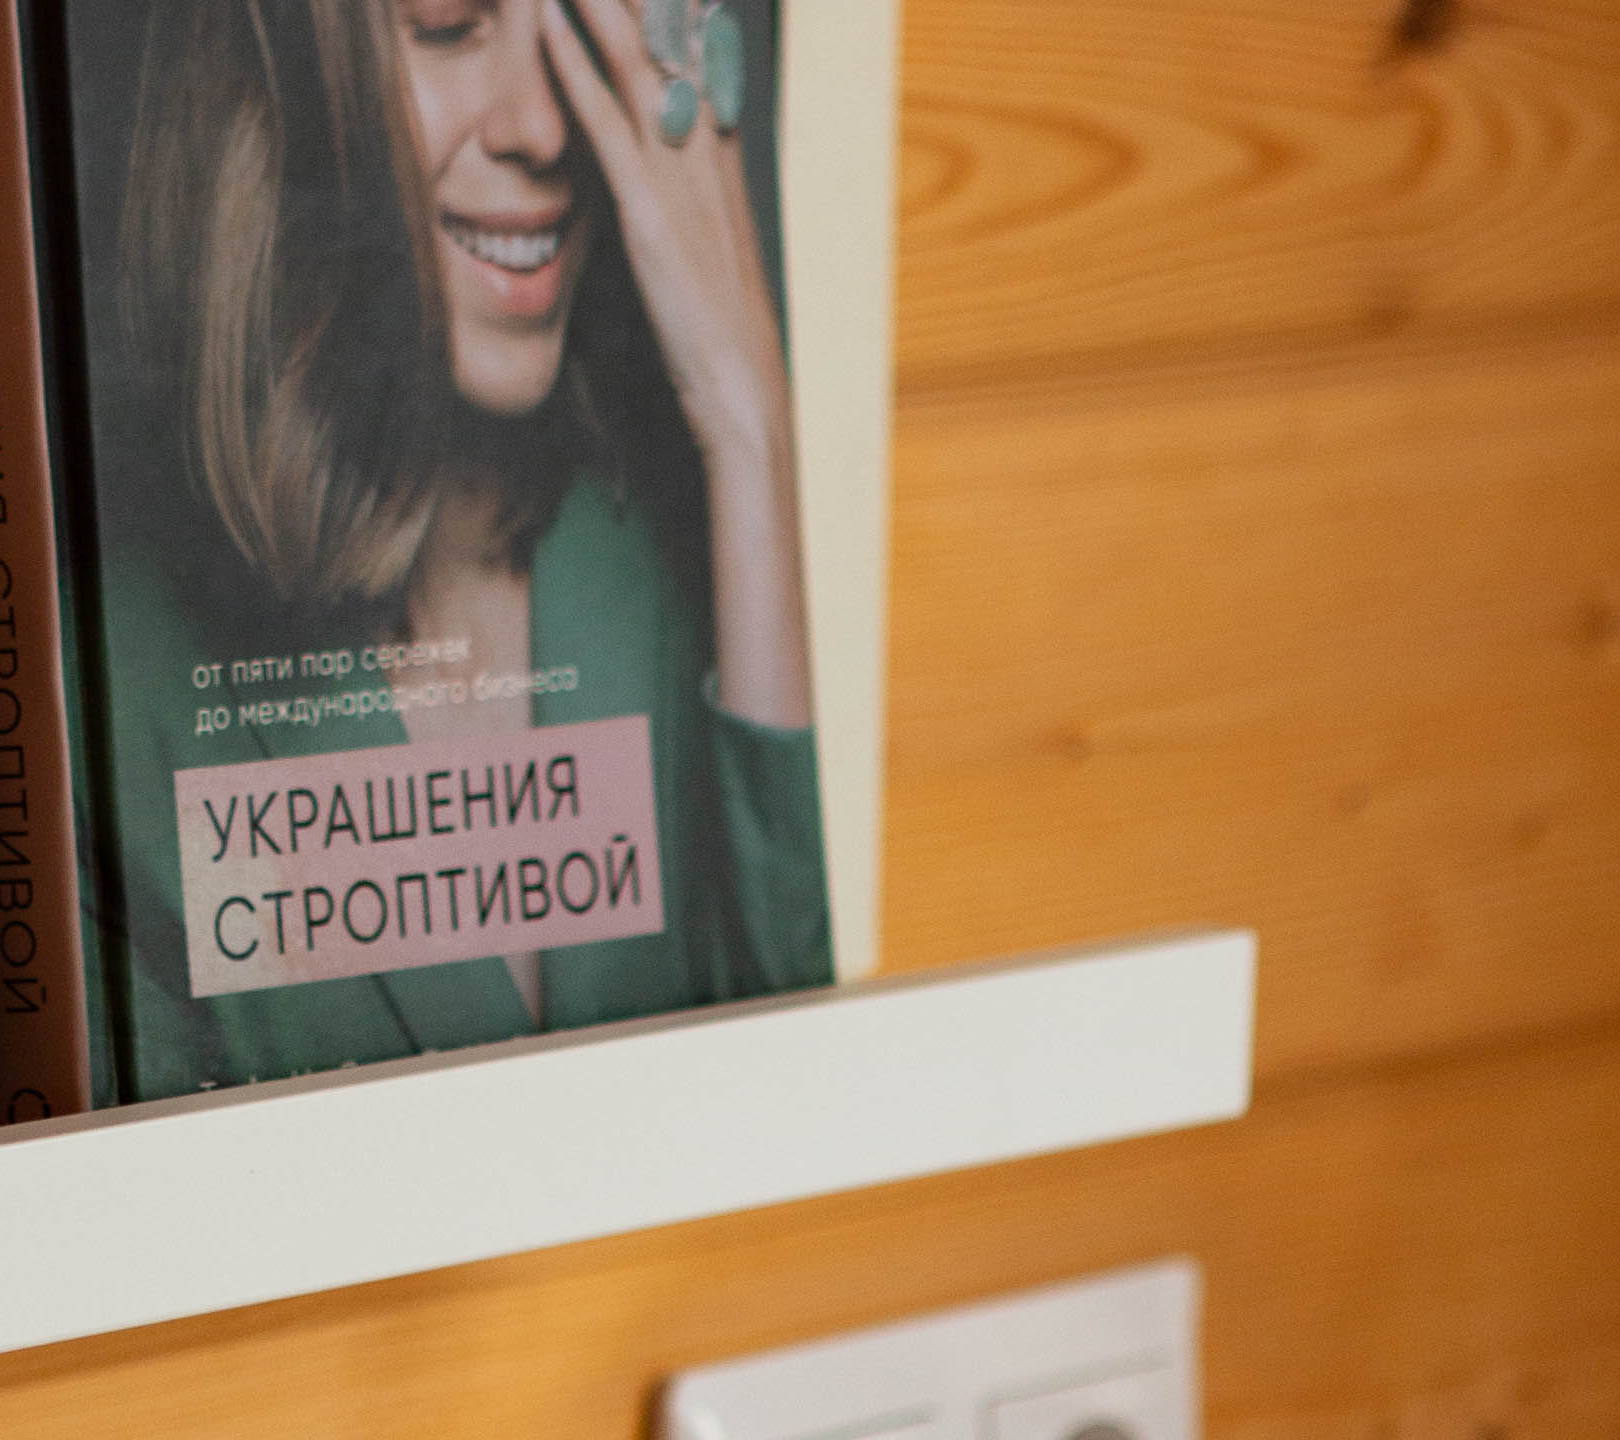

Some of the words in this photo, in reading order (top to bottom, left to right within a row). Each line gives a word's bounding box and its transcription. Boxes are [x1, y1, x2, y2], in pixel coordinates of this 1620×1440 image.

[192, 660, 222, 689] от
[232, 656, 294, 684] пяти
[301, 648, 354, 680] пар
[195, 705, 230, 736] до
[203, 756, 580, 863] УКРАШЕНИЯ
[213, 833, 642, 961] СТРОПТИВОЙ
